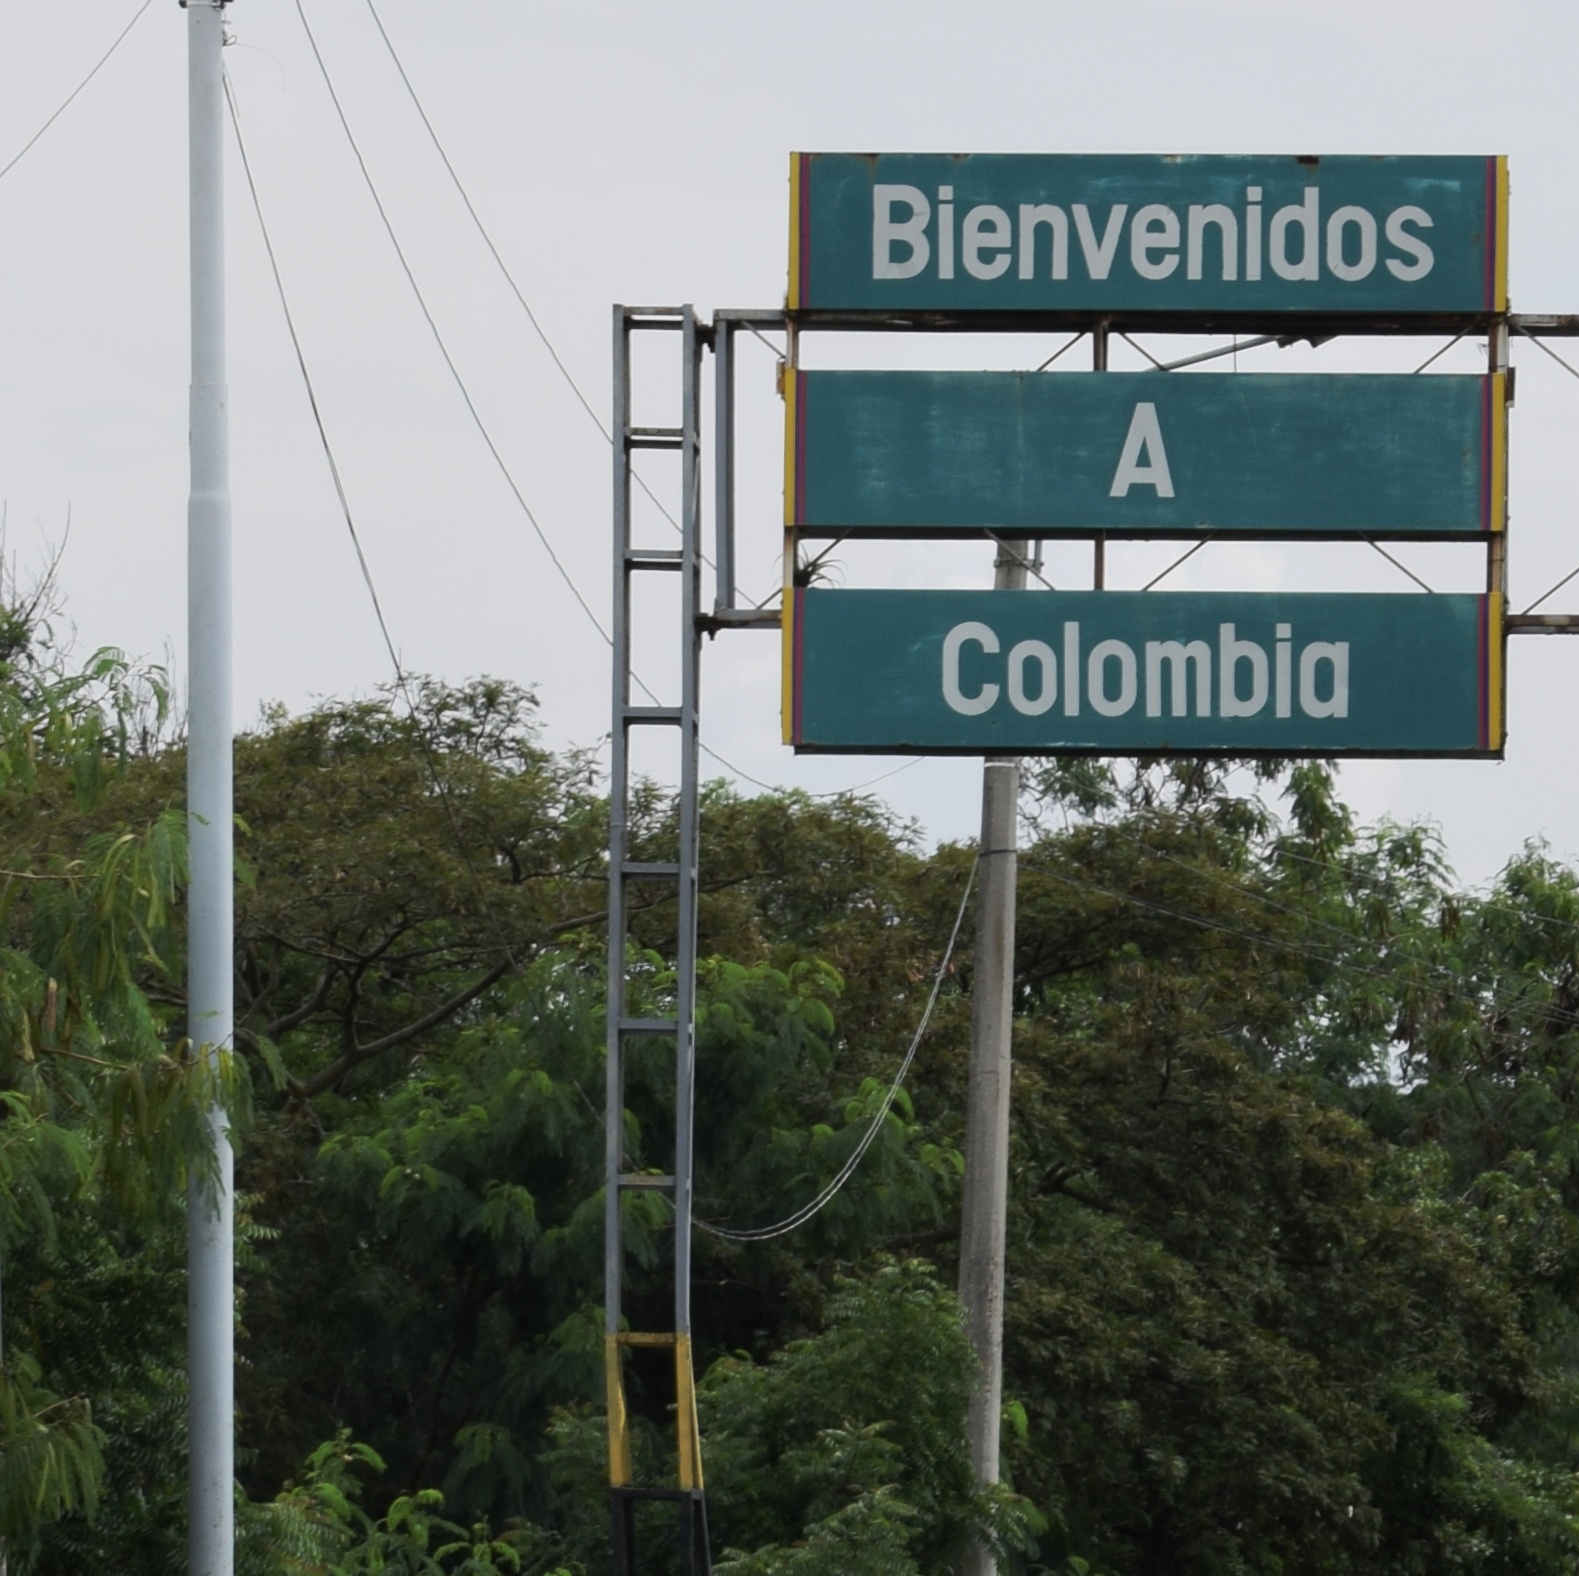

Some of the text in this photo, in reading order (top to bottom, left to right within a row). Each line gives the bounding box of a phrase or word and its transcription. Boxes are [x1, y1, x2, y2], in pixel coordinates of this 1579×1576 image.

[872, 182, 1435, 283] Bienvenidos
[1108, 401, 1176, 498] A
[940, 620, 1351, 719] Colombia
